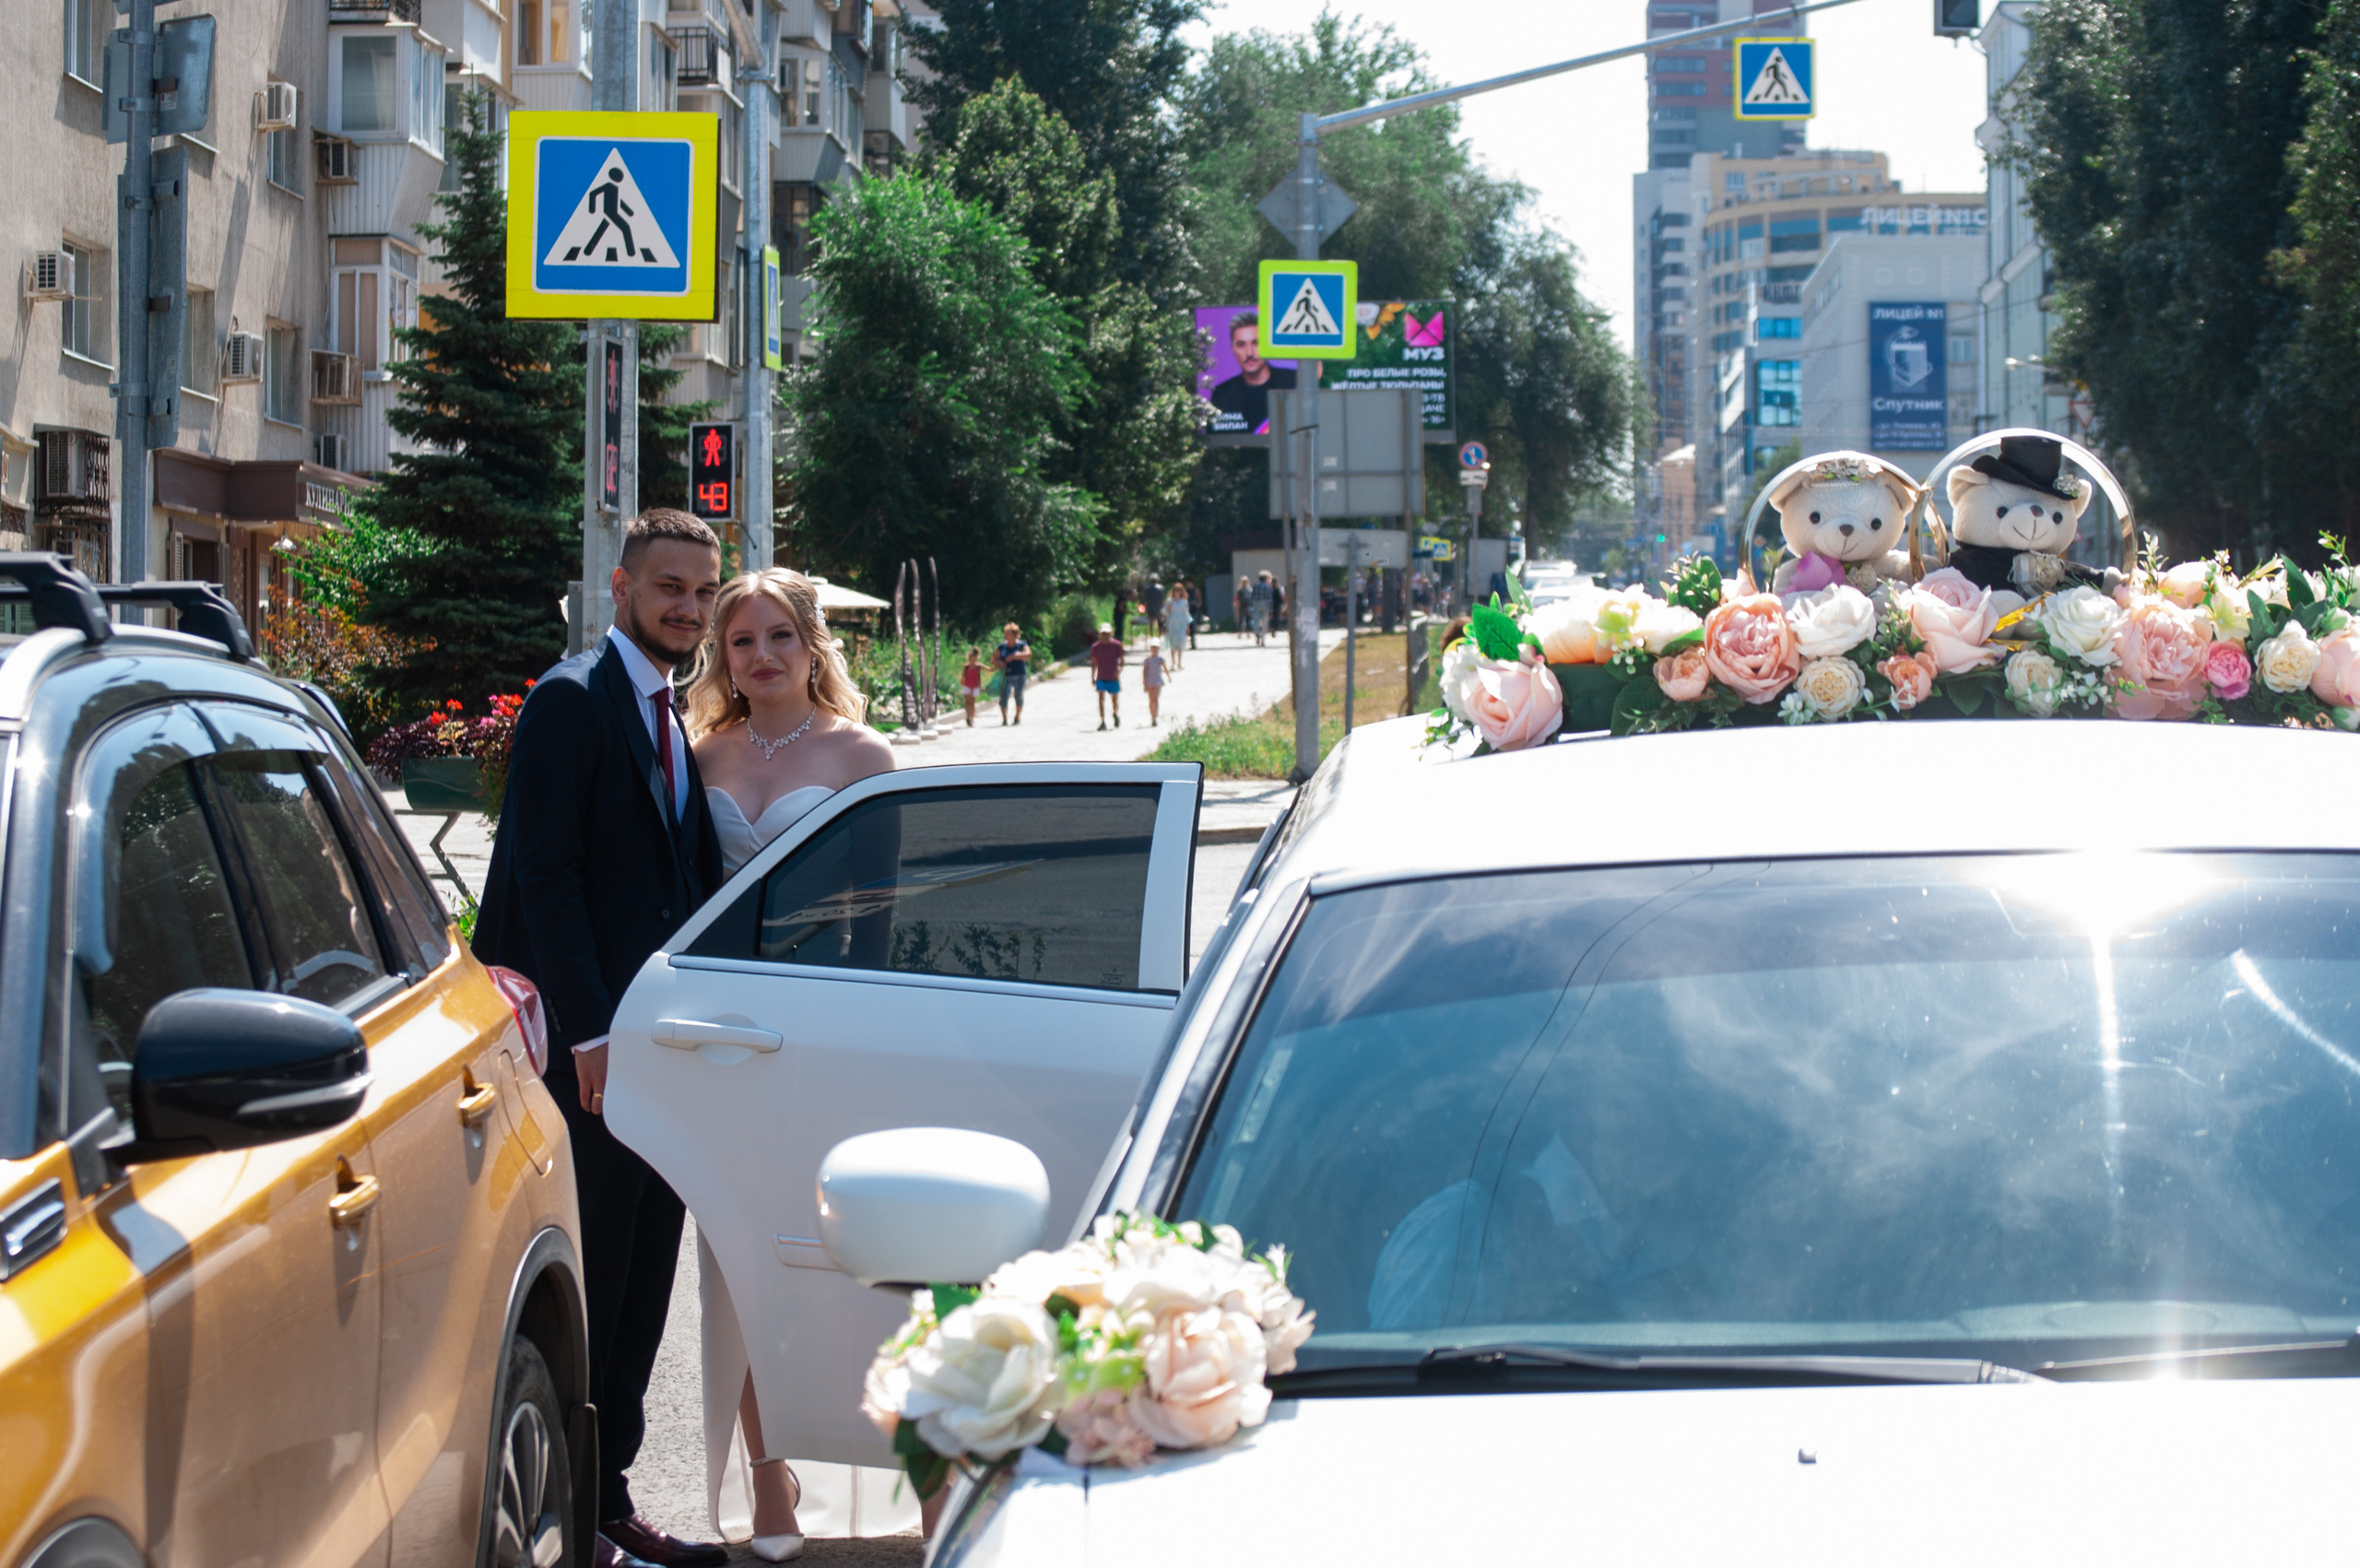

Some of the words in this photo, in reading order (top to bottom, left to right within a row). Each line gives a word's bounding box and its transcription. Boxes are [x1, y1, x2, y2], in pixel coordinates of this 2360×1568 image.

[1874, 305, 1924, 321] ЛИЦЕЙ
[1403, 347, 1446, 361] МУЗ
[1874, 397, 1944, 413] Спутник
[699, 482, 727, 512] 43
